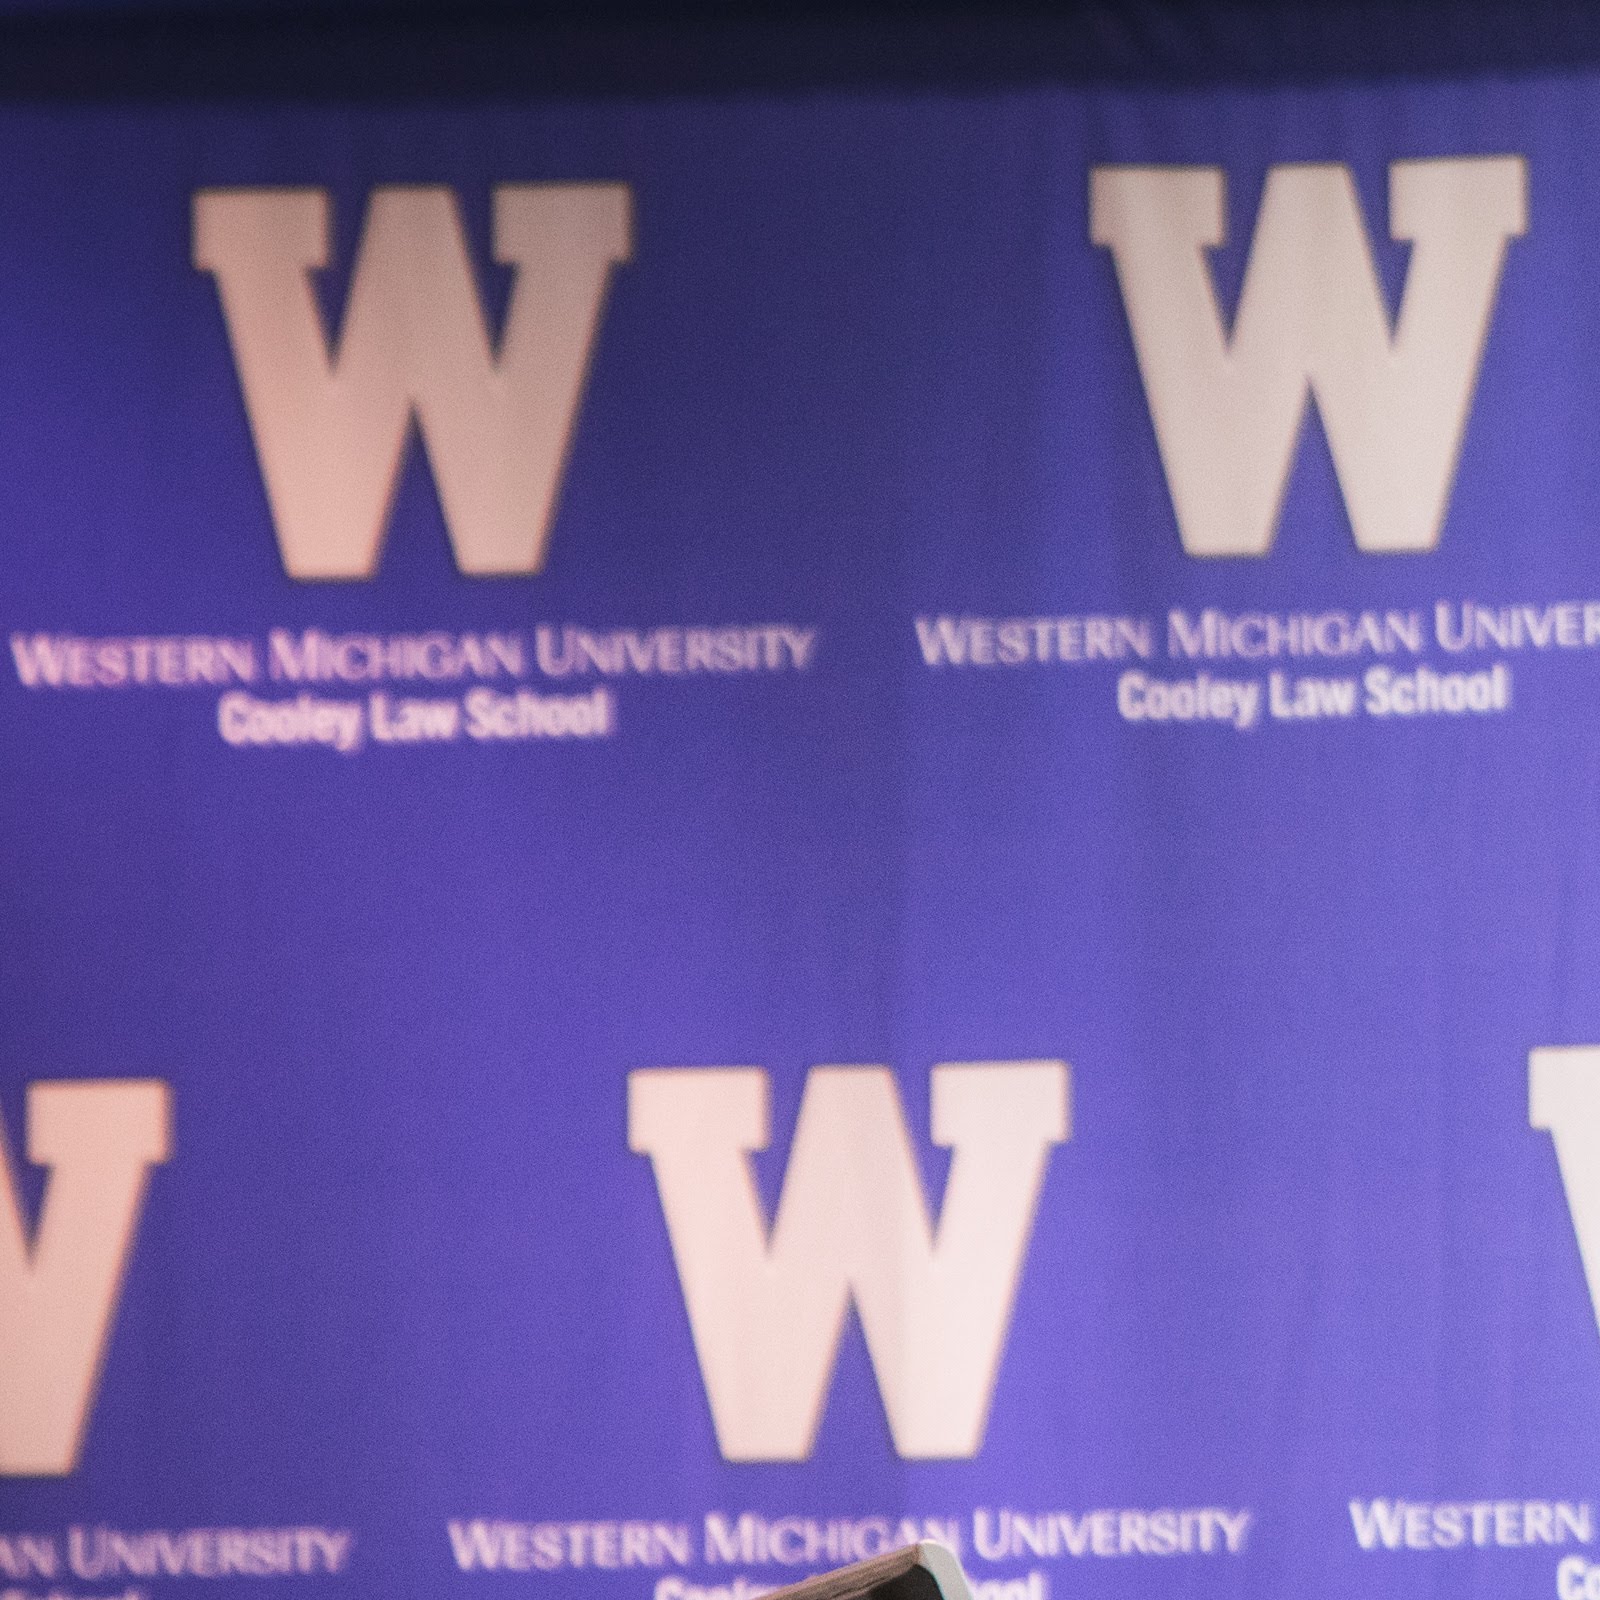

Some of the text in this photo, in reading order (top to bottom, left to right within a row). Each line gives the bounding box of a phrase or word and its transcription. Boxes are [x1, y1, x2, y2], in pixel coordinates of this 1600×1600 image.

[192, 181, 635, 581] W
[1089, 154, 1530, 557] W
[11, 623, 817, 688] WESTERN MICHIGAN UNIVERSITY
[916, 616, 1151, 667] WESTERN
[1168, 609, 1420, 660] MICHIGAN
[217, 686, 614, 753] Cooley Law School
[1117, 664, 1510, 731] Cooley Law School
[628, 1060, 1072, 1463] W
[68, 1525, 349, 1580] UNIVERSITY
[447, 1518, 689, 1571] WESTERN
[974, 1507, 1251, 1561] UNIVERSITY
[1348, 1497, 1591, 1550] WESTERN
